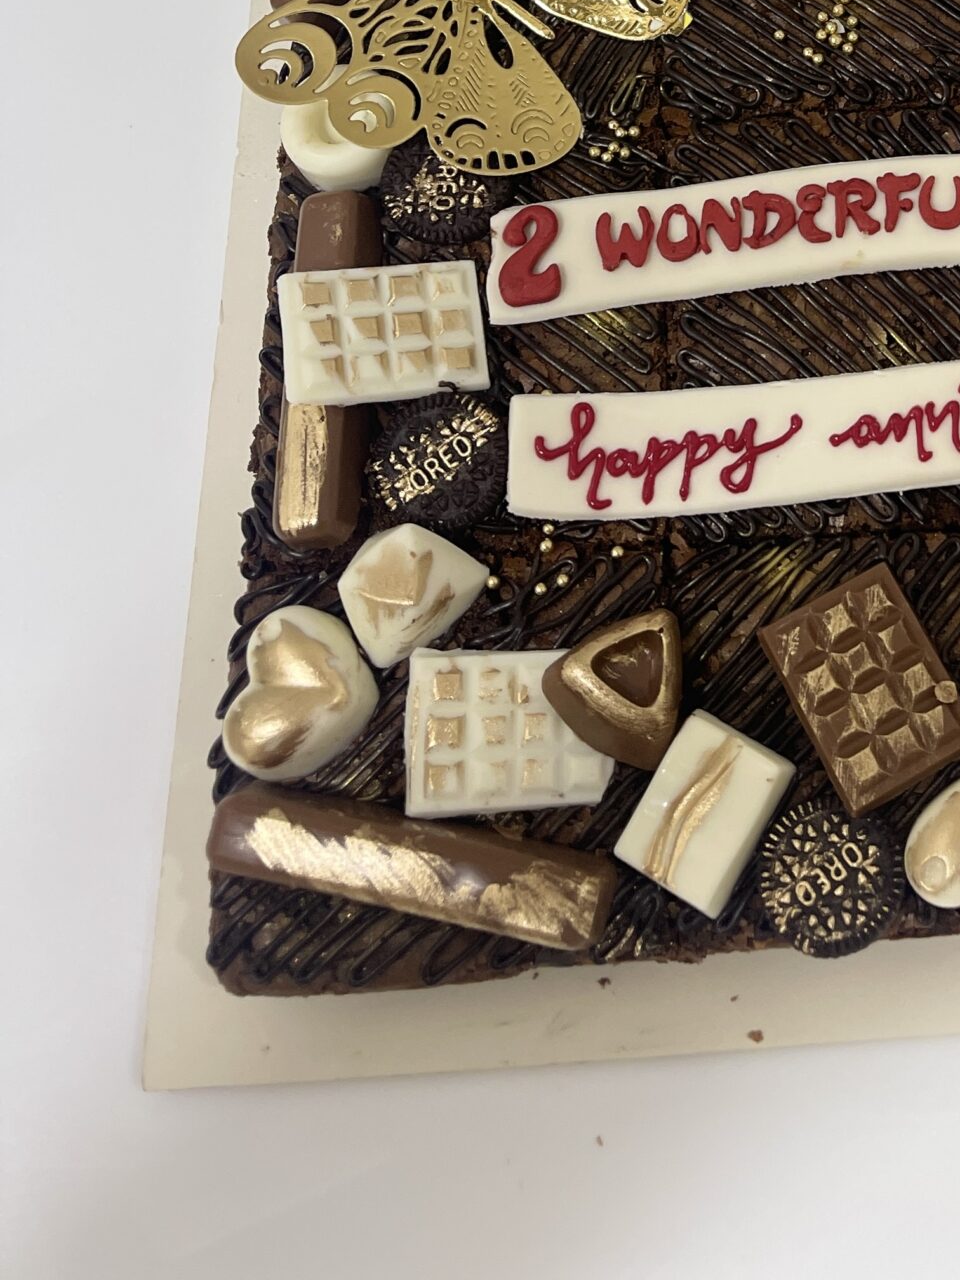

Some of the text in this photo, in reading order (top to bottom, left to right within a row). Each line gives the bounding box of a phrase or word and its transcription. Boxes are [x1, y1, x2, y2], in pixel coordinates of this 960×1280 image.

[431, 161, 459, 211] REO
[497, 205, 563, 307] 2
[409, 435, 472, 491] OREO
[534, 402, 803, 511] happy
[795, 841, 864, 908] OREO
